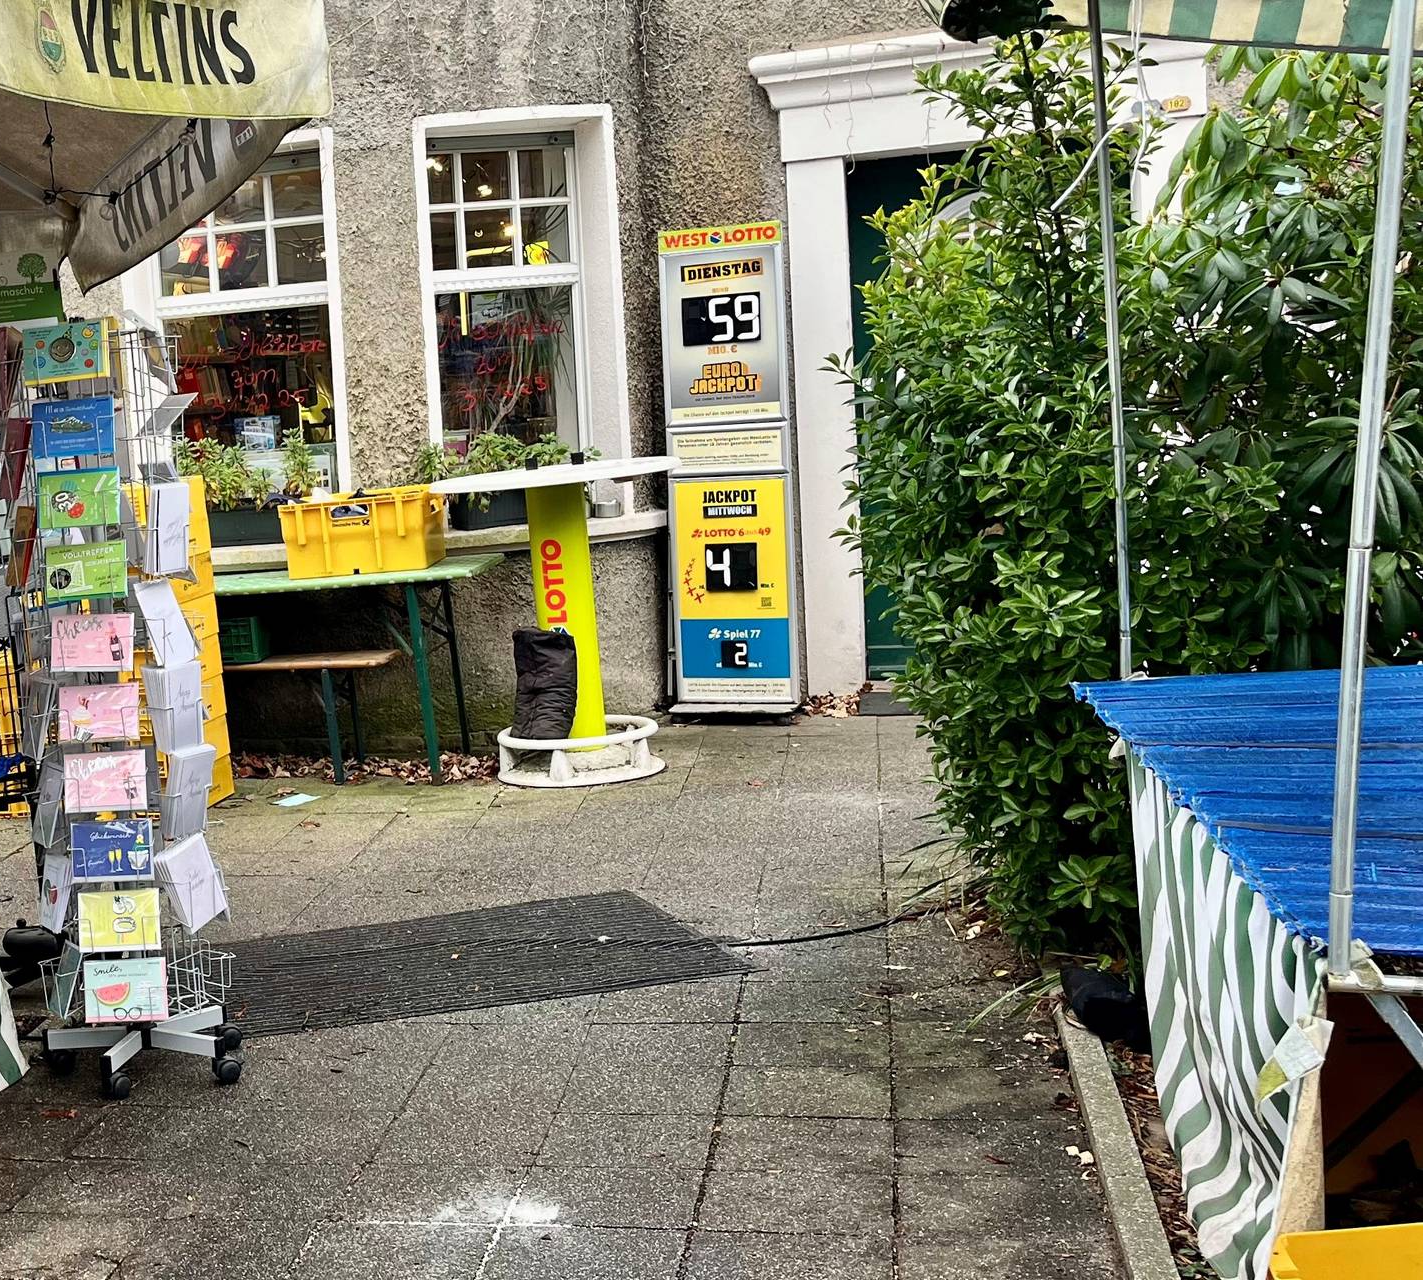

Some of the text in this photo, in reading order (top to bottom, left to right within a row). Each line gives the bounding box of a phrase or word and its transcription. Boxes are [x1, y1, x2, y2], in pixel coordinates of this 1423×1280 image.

[72, 0, 257, 85] VELTINS
[1169, 99, 1185, 108] 102
[663, 225, 777, 249] WEST LOTTO
[687, 260, 761, 281] DIENSTAG
[708, 294, 760, 342] 59
[702, 361, 742, 379] EURO
[689, 373, 758, 395] JACKPOT
[703, 489, 756, 504] JACKPOT
[707, 505, 753, 517] MITTWOCH
[704, 529, 736, 538] LOTTO
[706, 548, 731, 587] 4
[540, 539, 568, 624] LOTTO
[723, 629, 761, 640] Spiel 77
[734, 642, 747, 666] 2
